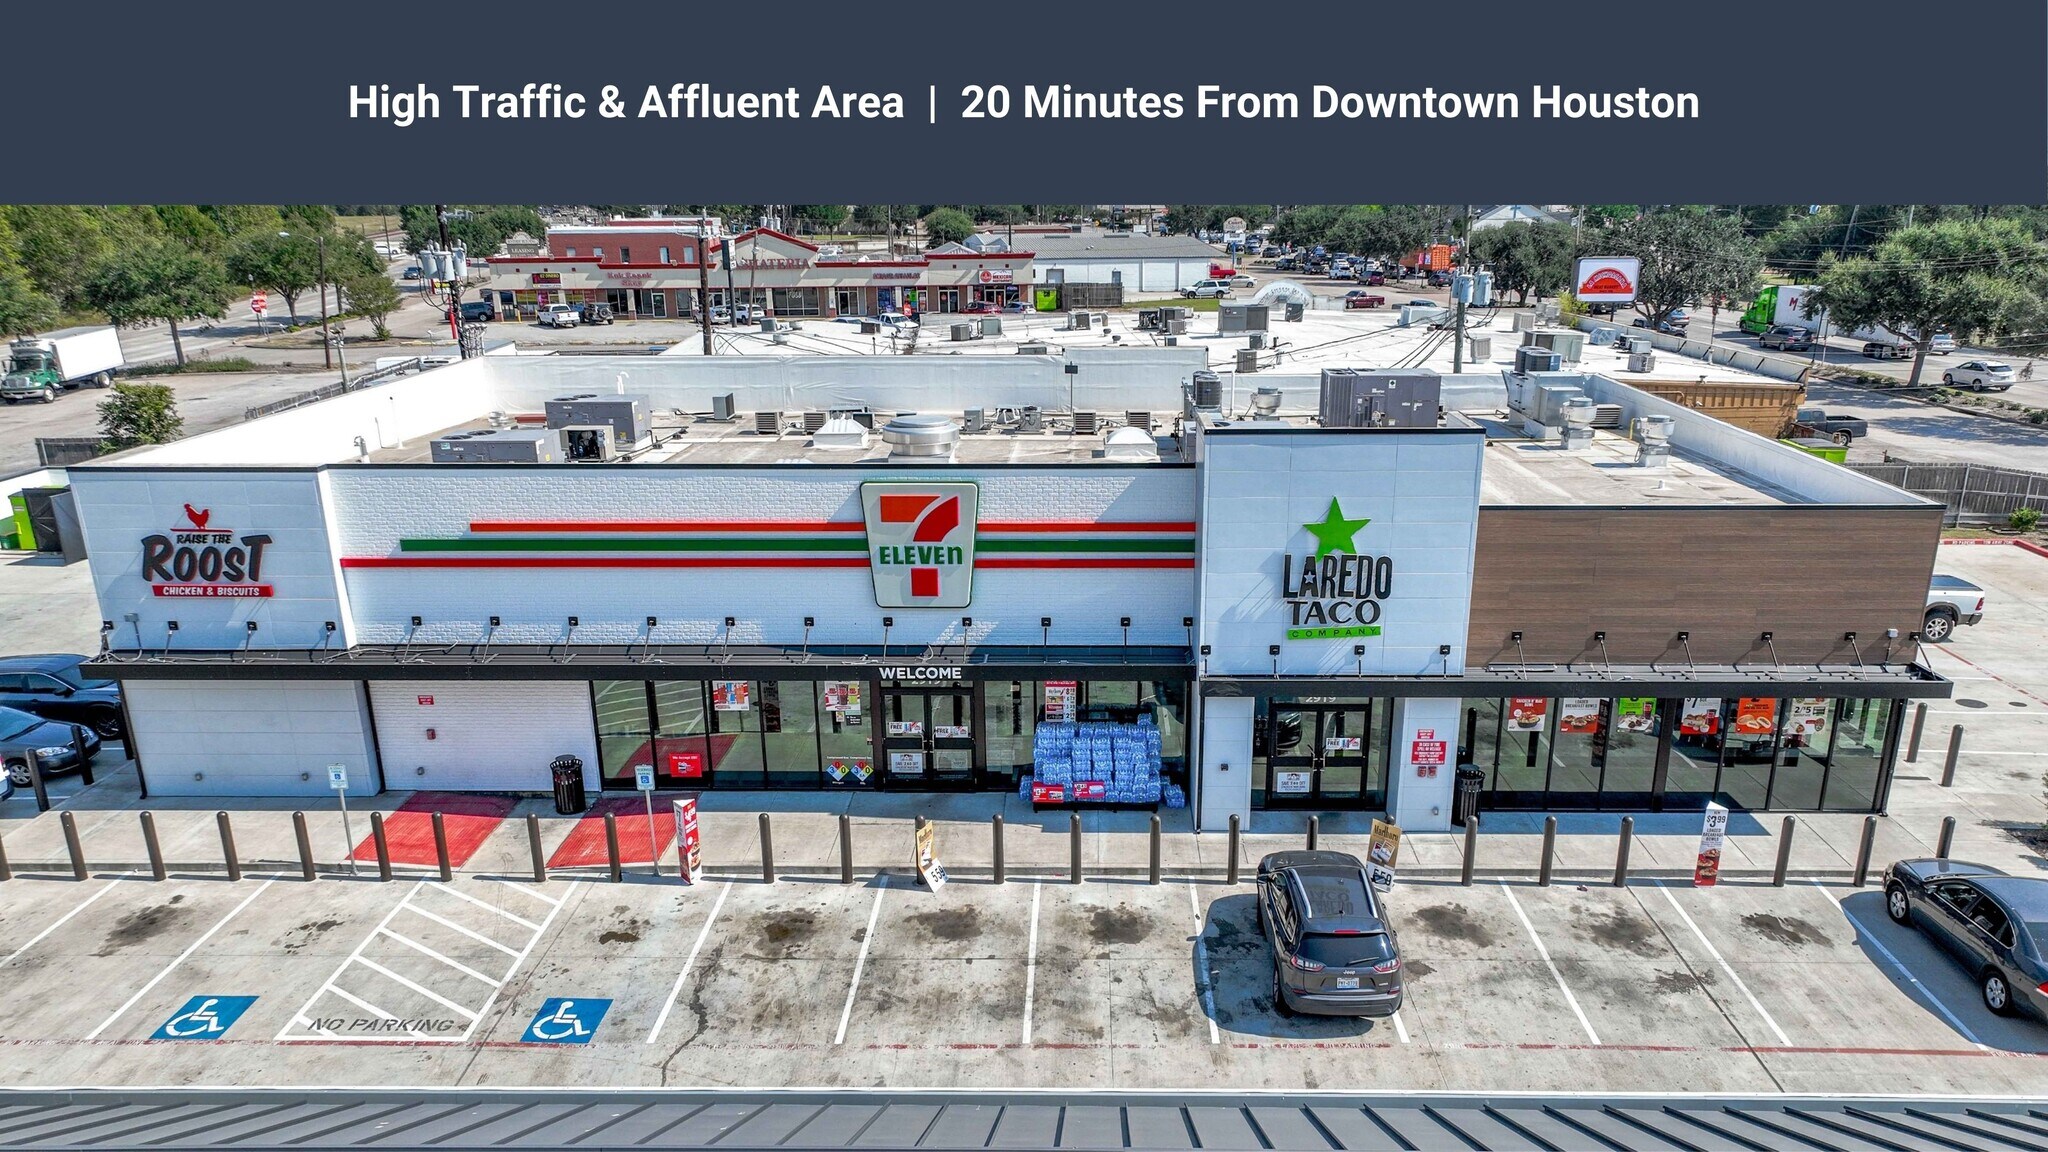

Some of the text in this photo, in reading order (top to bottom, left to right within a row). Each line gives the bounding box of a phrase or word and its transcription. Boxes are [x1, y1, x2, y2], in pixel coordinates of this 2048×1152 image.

[176, 534, 232, 544] RAISE THE
[880, 495, 959, 596] 7
[141, 534, 273, 582] ROOST
[1282, 554, 1393, 599] LAREDO
[163, 586, 260, 596] CHICKEN & BISCUITS
[1287, 600, 1381, 625] TACO
[1292, 628, 1376, 638] COMPANY
[879, 667, 962, 679] WELCOME
[307, 1018, 455, 1032] NO PARKING
